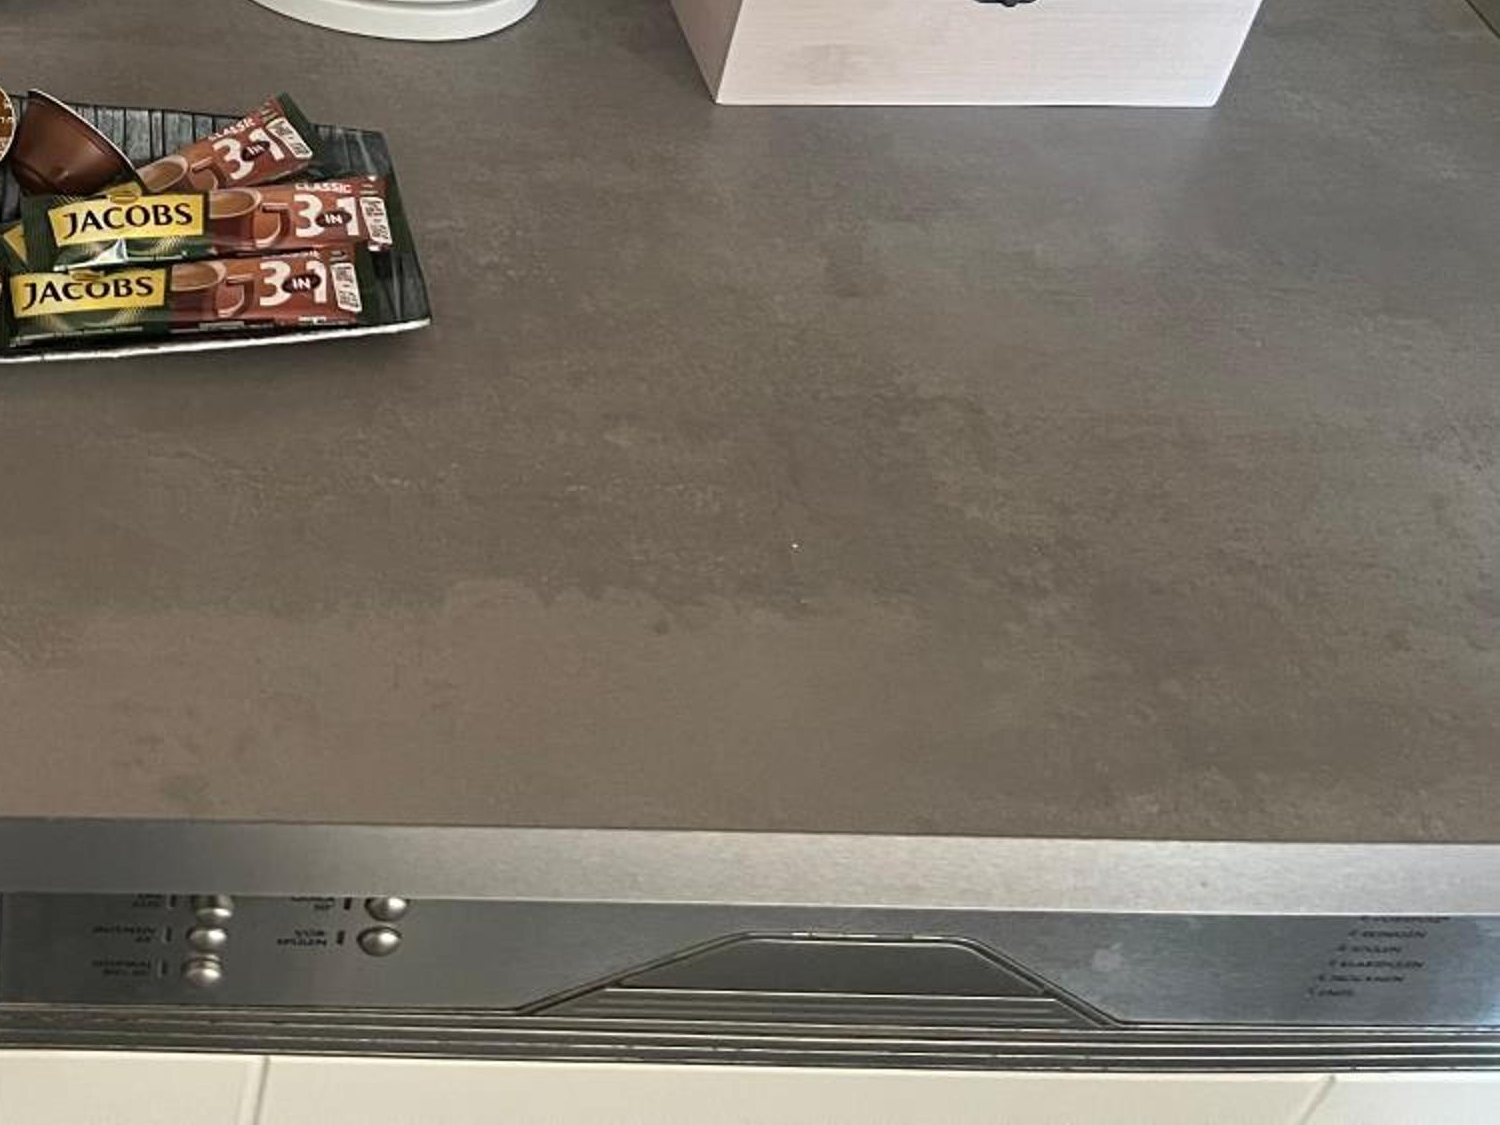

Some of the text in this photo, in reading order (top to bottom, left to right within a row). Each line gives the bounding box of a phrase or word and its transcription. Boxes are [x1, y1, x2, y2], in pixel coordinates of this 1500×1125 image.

[212, 137, 255, 180] 3
[63, 203, 193, 240] JACOBS
[293, 193, 325, 238] 3
[335, 196, 360, 236] 1
[22, 276, 155, 311] JACOBS
[259, 260, 292, 306] 3
[305, 260, 329, 304] 1
